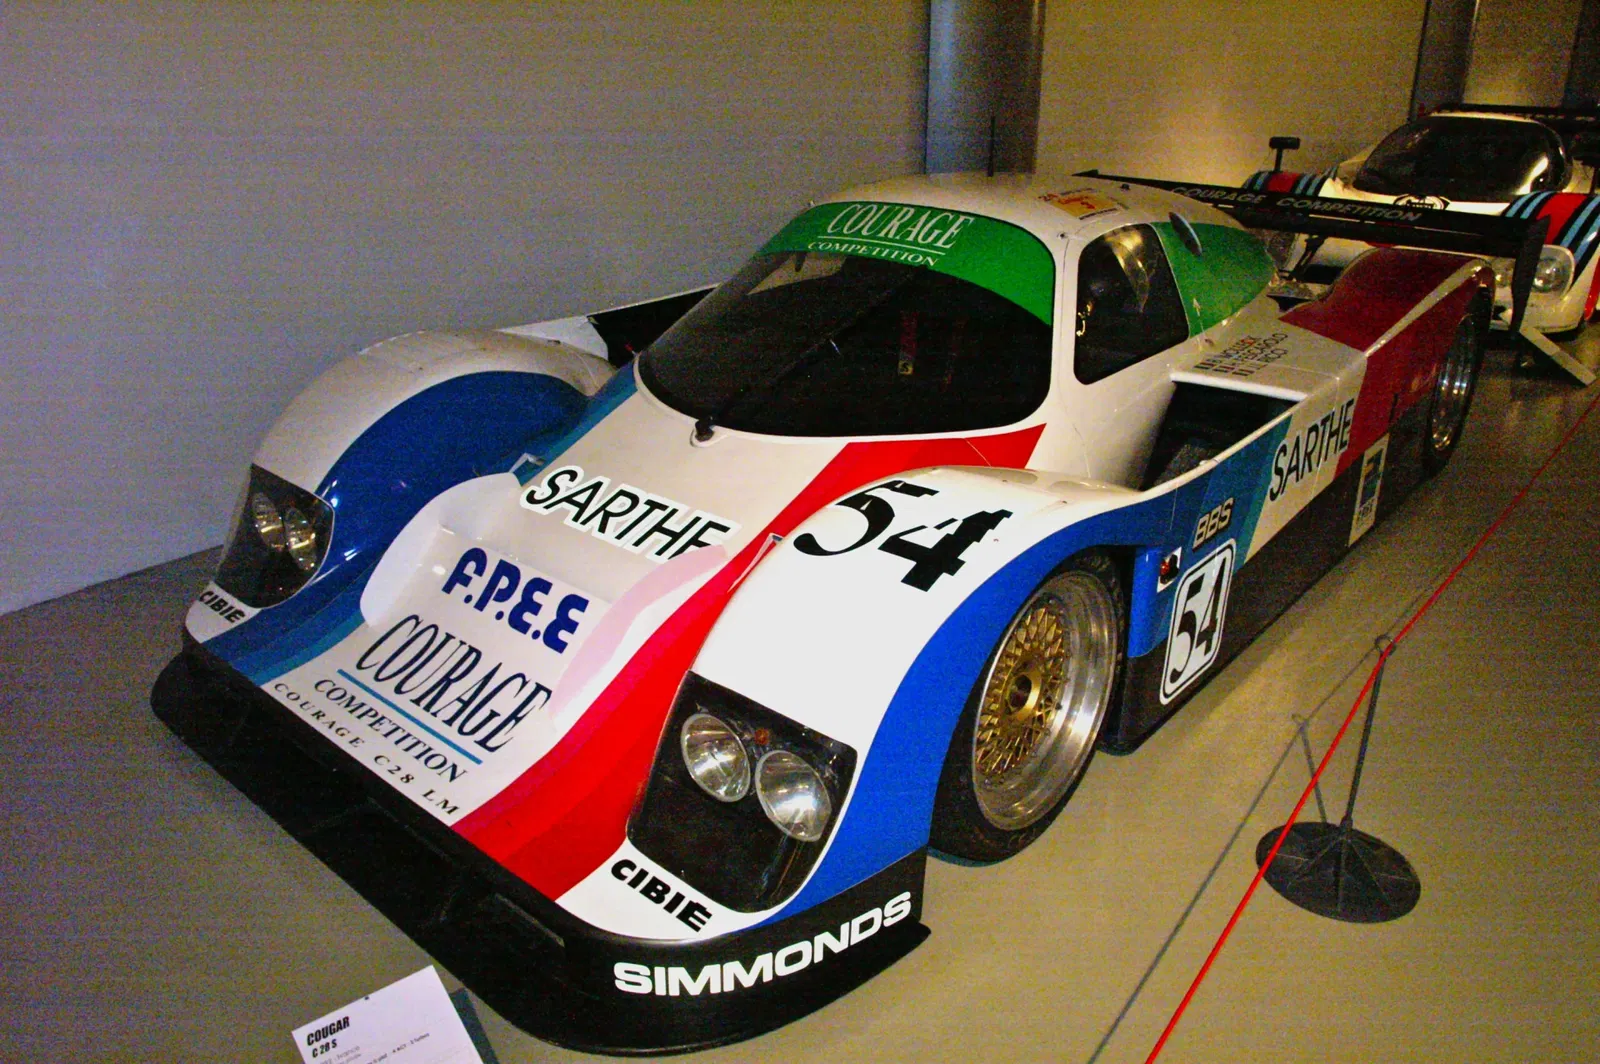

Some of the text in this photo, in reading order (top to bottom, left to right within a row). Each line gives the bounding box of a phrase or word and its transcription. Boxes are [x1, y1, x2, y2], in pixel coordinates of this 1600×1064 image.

[807, 241, 939, 266] COMPETITION
[827, 204, 974, 249] COURAGE
[1172, 187, 1422, 221] COURAGE COMPETITION
[1269, 398, 1355, 502] SARTHE
[793, 480, 1013, 592] 54
[1192, 497, 1234, 551] BBS
[1169, 557, 1227, 684] 54
[313, 679, 468, 783] COMPETITION
[355, 614, 552, 753] COURAGE
[274, 682, 460, 816] COURAGE C28 LM
[613, 891, 912, 997] SIMMONDS
[306, 1016, 350, 1046] COUGAR
[311, 1039, 338, 1059] C 28 S
